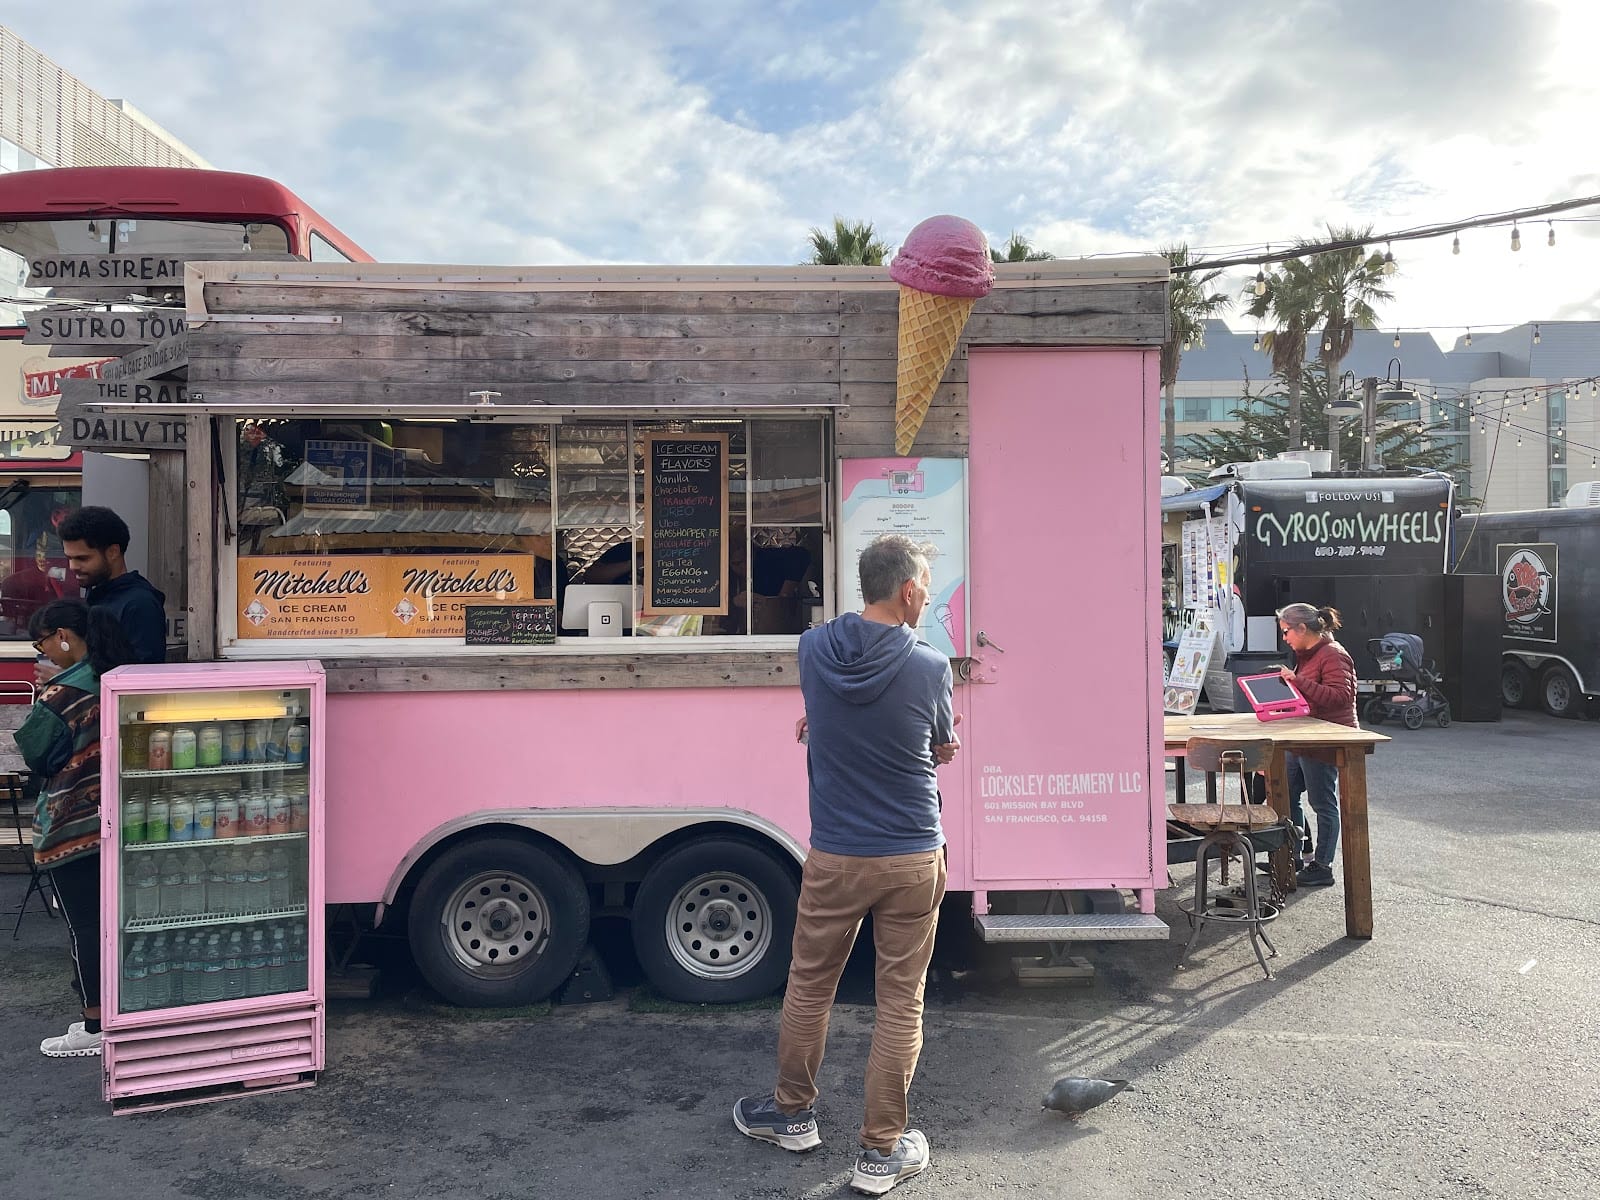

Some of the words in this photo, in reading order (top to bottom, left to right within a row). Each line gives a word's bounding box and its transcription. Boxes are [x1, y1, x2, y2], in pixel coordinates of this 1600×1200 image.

[32, 261, 91, 278] SOMA
[99, 258, 179, 279] STREAT
[41, 318, 126, 338] SUTRO
[128, 358, 142, 375] GATE
[98, 384, 128, 398] THE
[73, 418, 150, 442] DAILY
[657, 445, 674, 454] ICE
[677, 445, 717, 454] CREAM
[661, 459, 712, 469] FLAVORS
[656, 473, 689, 484] Vanilla
[655, 485, 699, 496] Chocolate
[1320, 493, 1362, 501] FOLLOW
[1366, 493, 1381, 501] US!
[660, 506, 695, 517] OREO
[654, 528, 707, 538] GRASSHOPPER
[709, 529, 720, 537] PIE
[1257, 511, 1331, 546] GYROS
[1357, 511, 1443, 544] WHEELS
[442, 559, 480, 567] Featuring
[657, 560, 674, 568] Thai
[677, 558, 693, 567] Tea
[662, 568, 702, 577] EGGNOG
[254, 570, 372, 600] Mitchell's
[403, 569, 519, 599] Mitchell's
[656, 588, 681, 596] Mango
[279, 605, 299, 613] ICE
[303, 605, 347, 613] CREAM
[430, 604, 448, 612] CE
[416, 627, 464, 635] Handcrafted
[984, 766, 1002, 774] DBA
[981, 775, 1044, 798] LOCKSLEY
[1048, 773, 1115, 796] CREAMERY
[1120, 772, 1142, 793] LLC
[985, 802, 1001, 810] 601
[1002, 802, 1037, 810] MISSION
[1061, 801, 1084, 809] BLVD
[1006, 815, 1060, 824] FRANCISCO,
[1080, 815, 1108, 823] 94158
[786, 1121, 816, 1134] ecco
[860, 1162, 889, 1174] ecco
